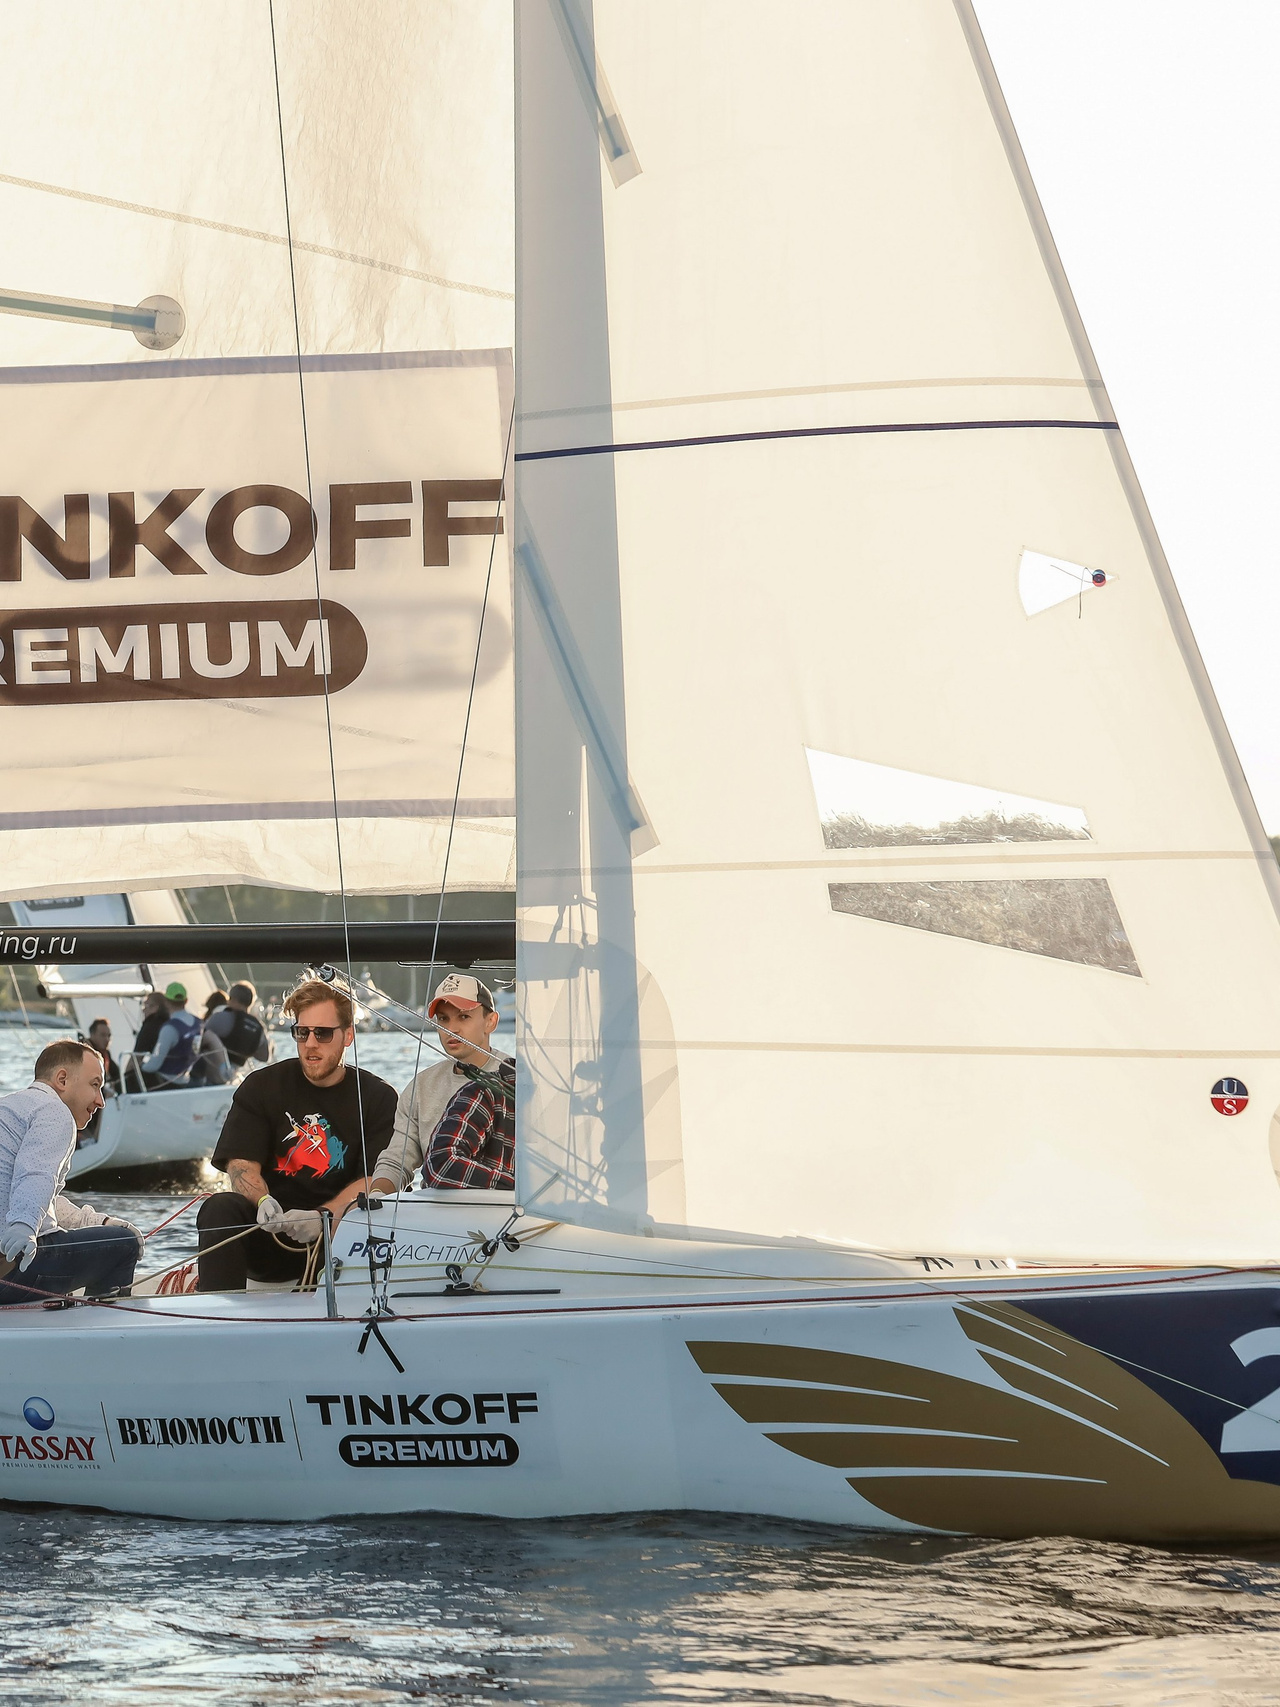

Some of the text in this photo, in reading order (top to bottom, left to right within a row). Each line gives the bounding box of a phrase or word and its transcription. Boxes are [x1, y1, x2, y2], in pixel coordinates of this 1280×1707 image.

[306, 1392, 539, 1426] TINKOFF
[117, 1416, 286, 1448] ВЕДОМОСТИ
[349, 1440, 508, 1462] PREMIUM
